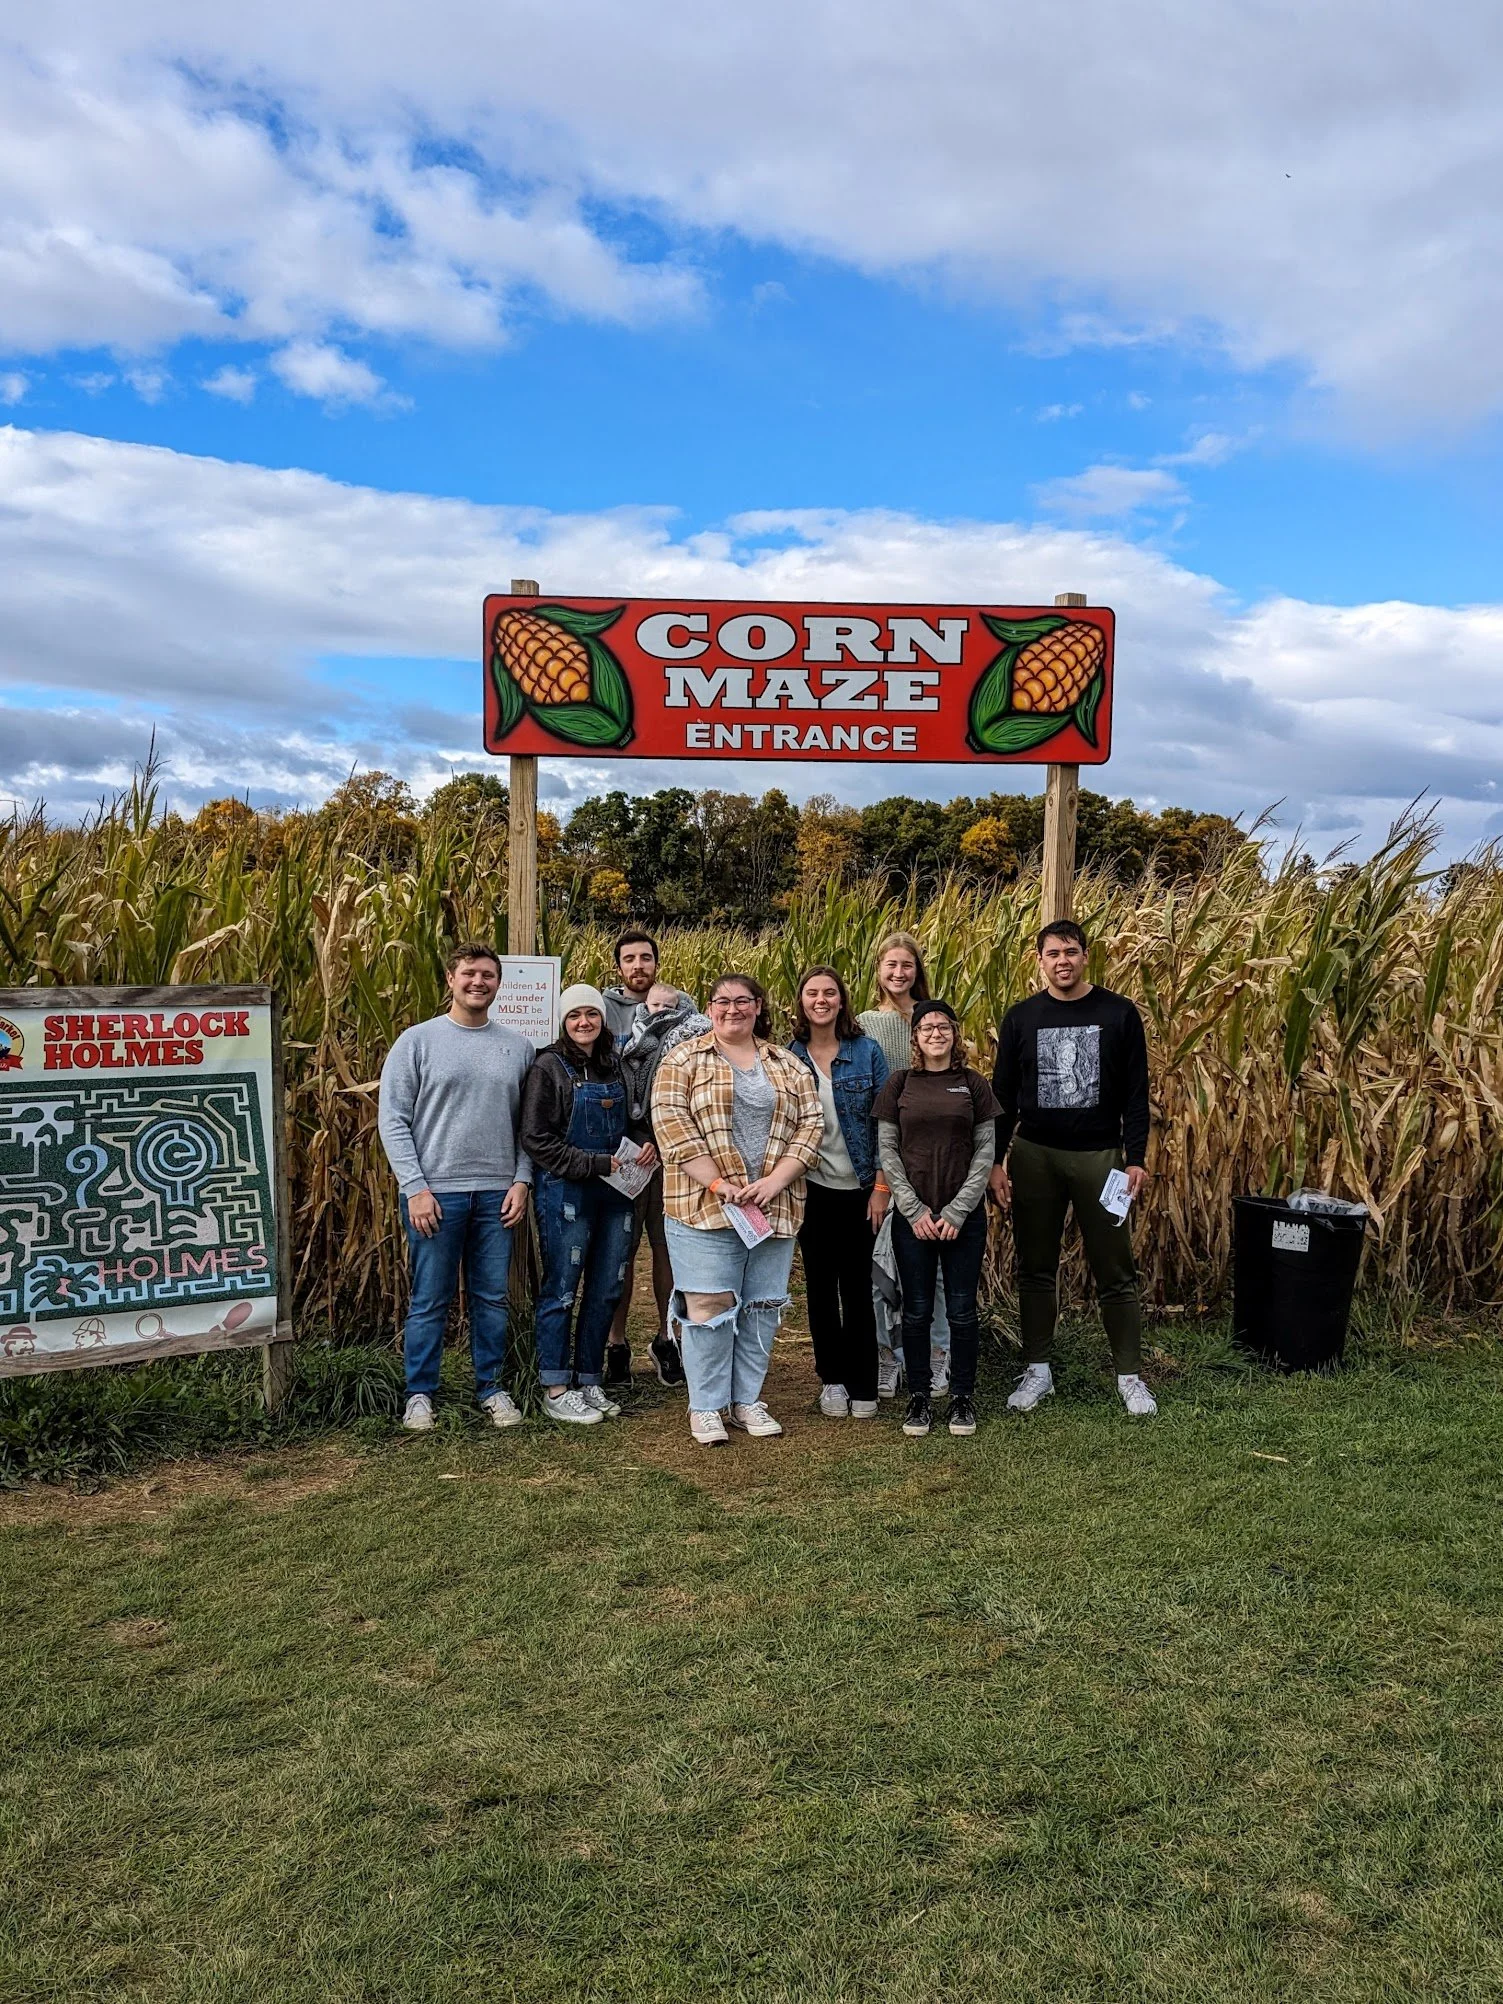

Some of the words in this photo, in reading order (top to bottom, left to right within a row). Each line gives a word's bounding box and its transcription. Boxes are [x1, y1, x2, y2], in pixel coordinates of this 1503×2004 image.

[636, 612, 968, 665] CORN
[663, 666, 940, 712] MAZE
[686, 722, 918, 752] ENTRANCE
[496, 993, 514, 1001] and
[516, 993, 545, 1002] under
[499, 981, 533, 990] hildren
[535, 982, 547, 991] 14
[492, 1017, 550, 1027] ccompanied
[498, 1005, 529, 1014] MUST
[531, 1005, 543, 1014] be
[44, 1011, 250, 1042] SHERLOCK
[517, 1028, 539, 1037] dult
[541, 1028, 549, 1037] in
[43, 1039, 204, 1071] HOLMES
[98, 1244, 268, 1284] HOLMES
